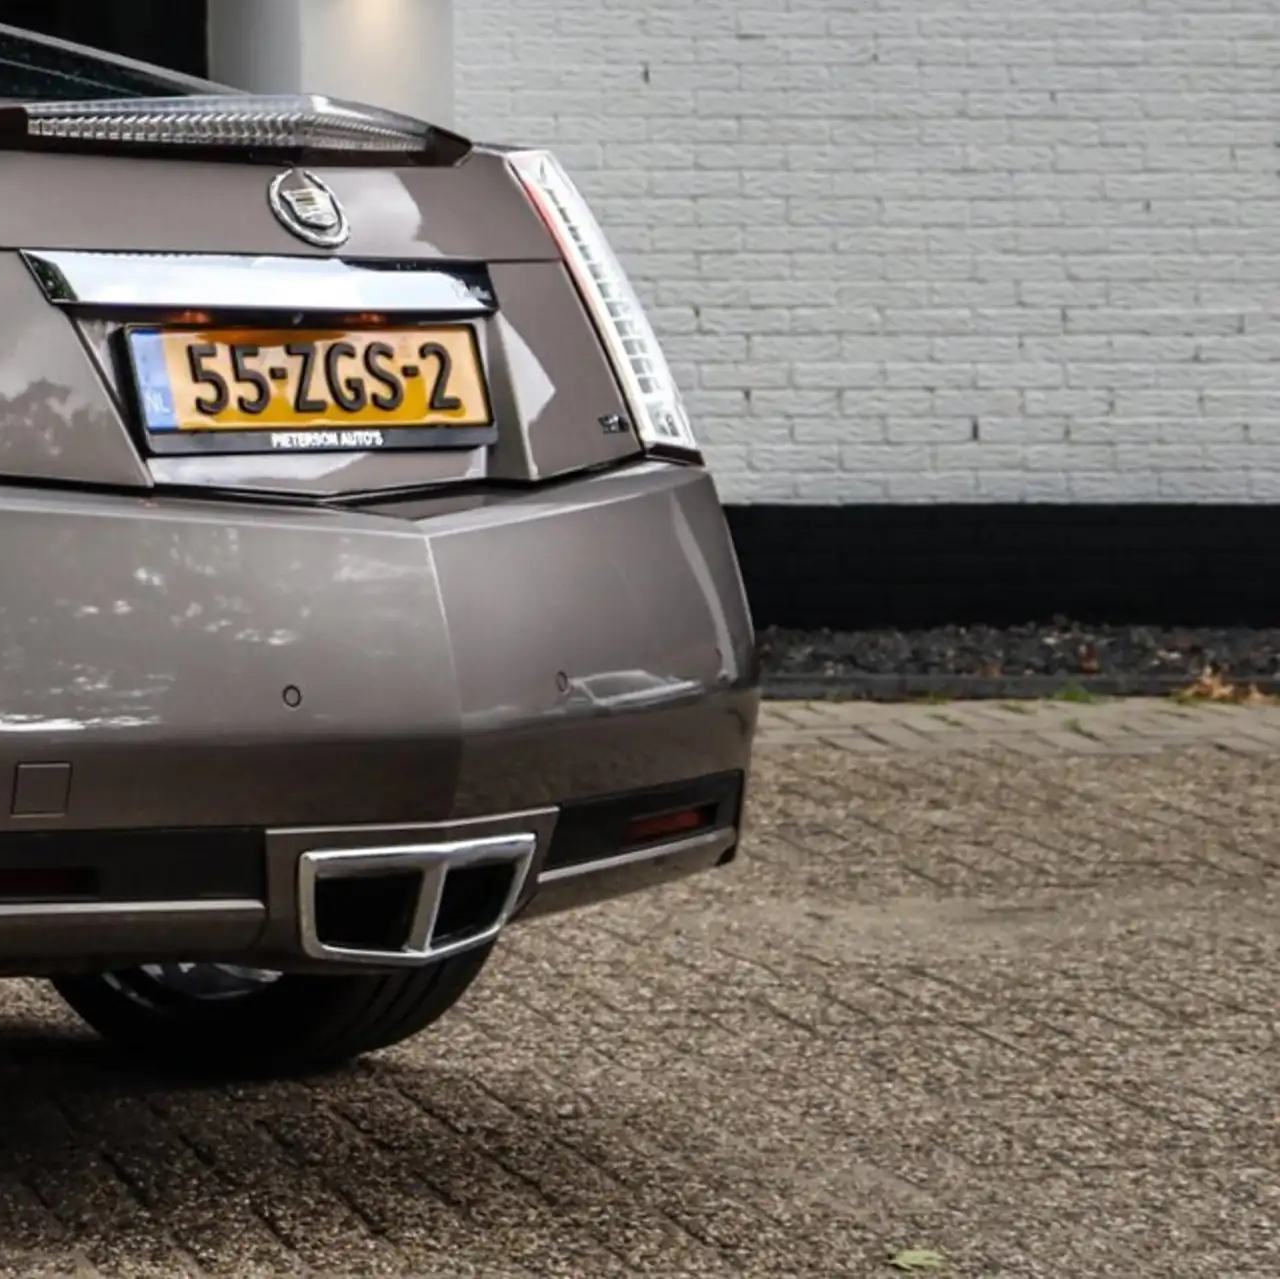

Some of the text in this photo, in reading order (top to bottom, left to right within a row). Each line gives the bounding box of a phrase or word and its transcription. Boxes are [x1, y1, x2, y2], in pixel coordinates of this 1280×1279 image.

[186, 341, 462, 415] 55-ZGS-2
[145, 390, 171, 413] NL
[271, 429, 384, 448] PIETERSON AUTO'S
